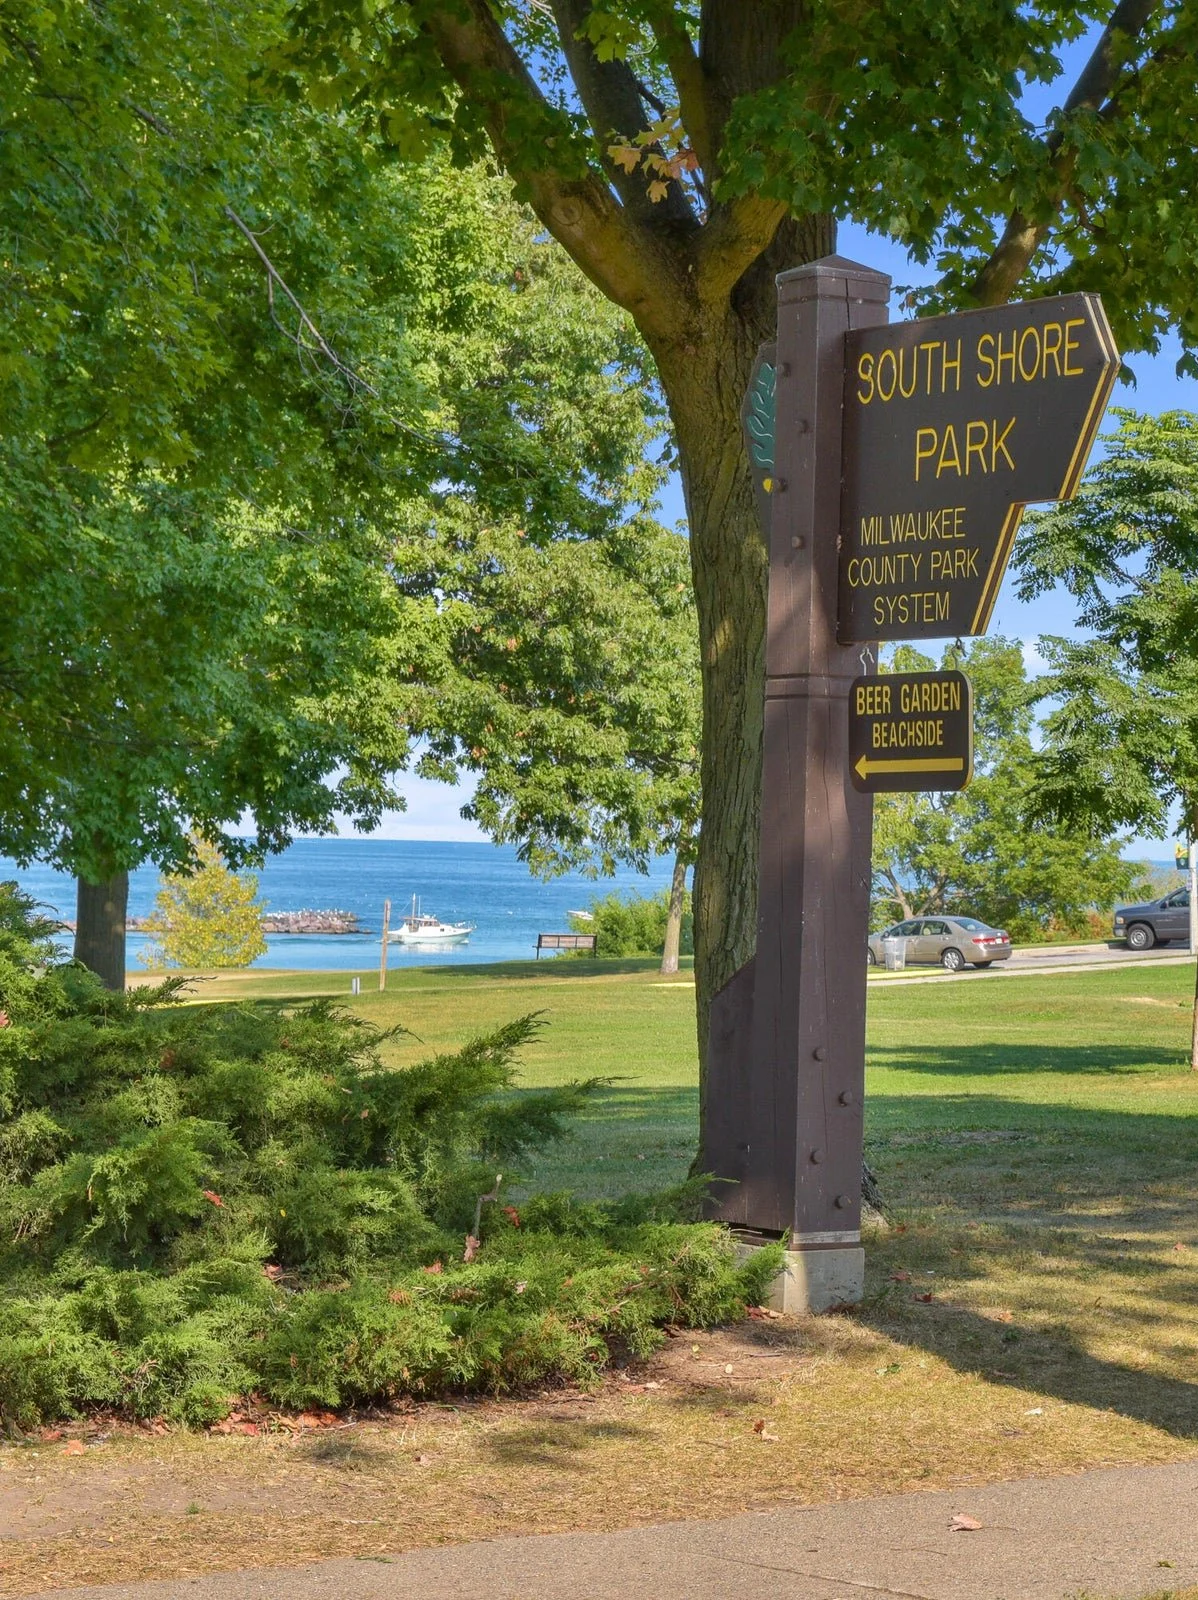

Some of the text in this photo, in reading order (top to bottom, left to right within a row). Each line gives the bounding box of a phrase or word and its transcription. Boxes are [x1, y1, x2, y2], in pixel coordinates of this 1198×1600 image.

[857, 318, 1086, 405] SOUTH SHORE
[915, 416, 1017, 483] PARK
[860, 507, 966, 546] MILWAUKEE
[848, 548, 980, 588] COUNTY PARK
[873, 591, 950, 625] SYSTEM
[856, 681, 961, 715] BEER GARDEN
[872, 719, 944, 748] BEACHSIDE
